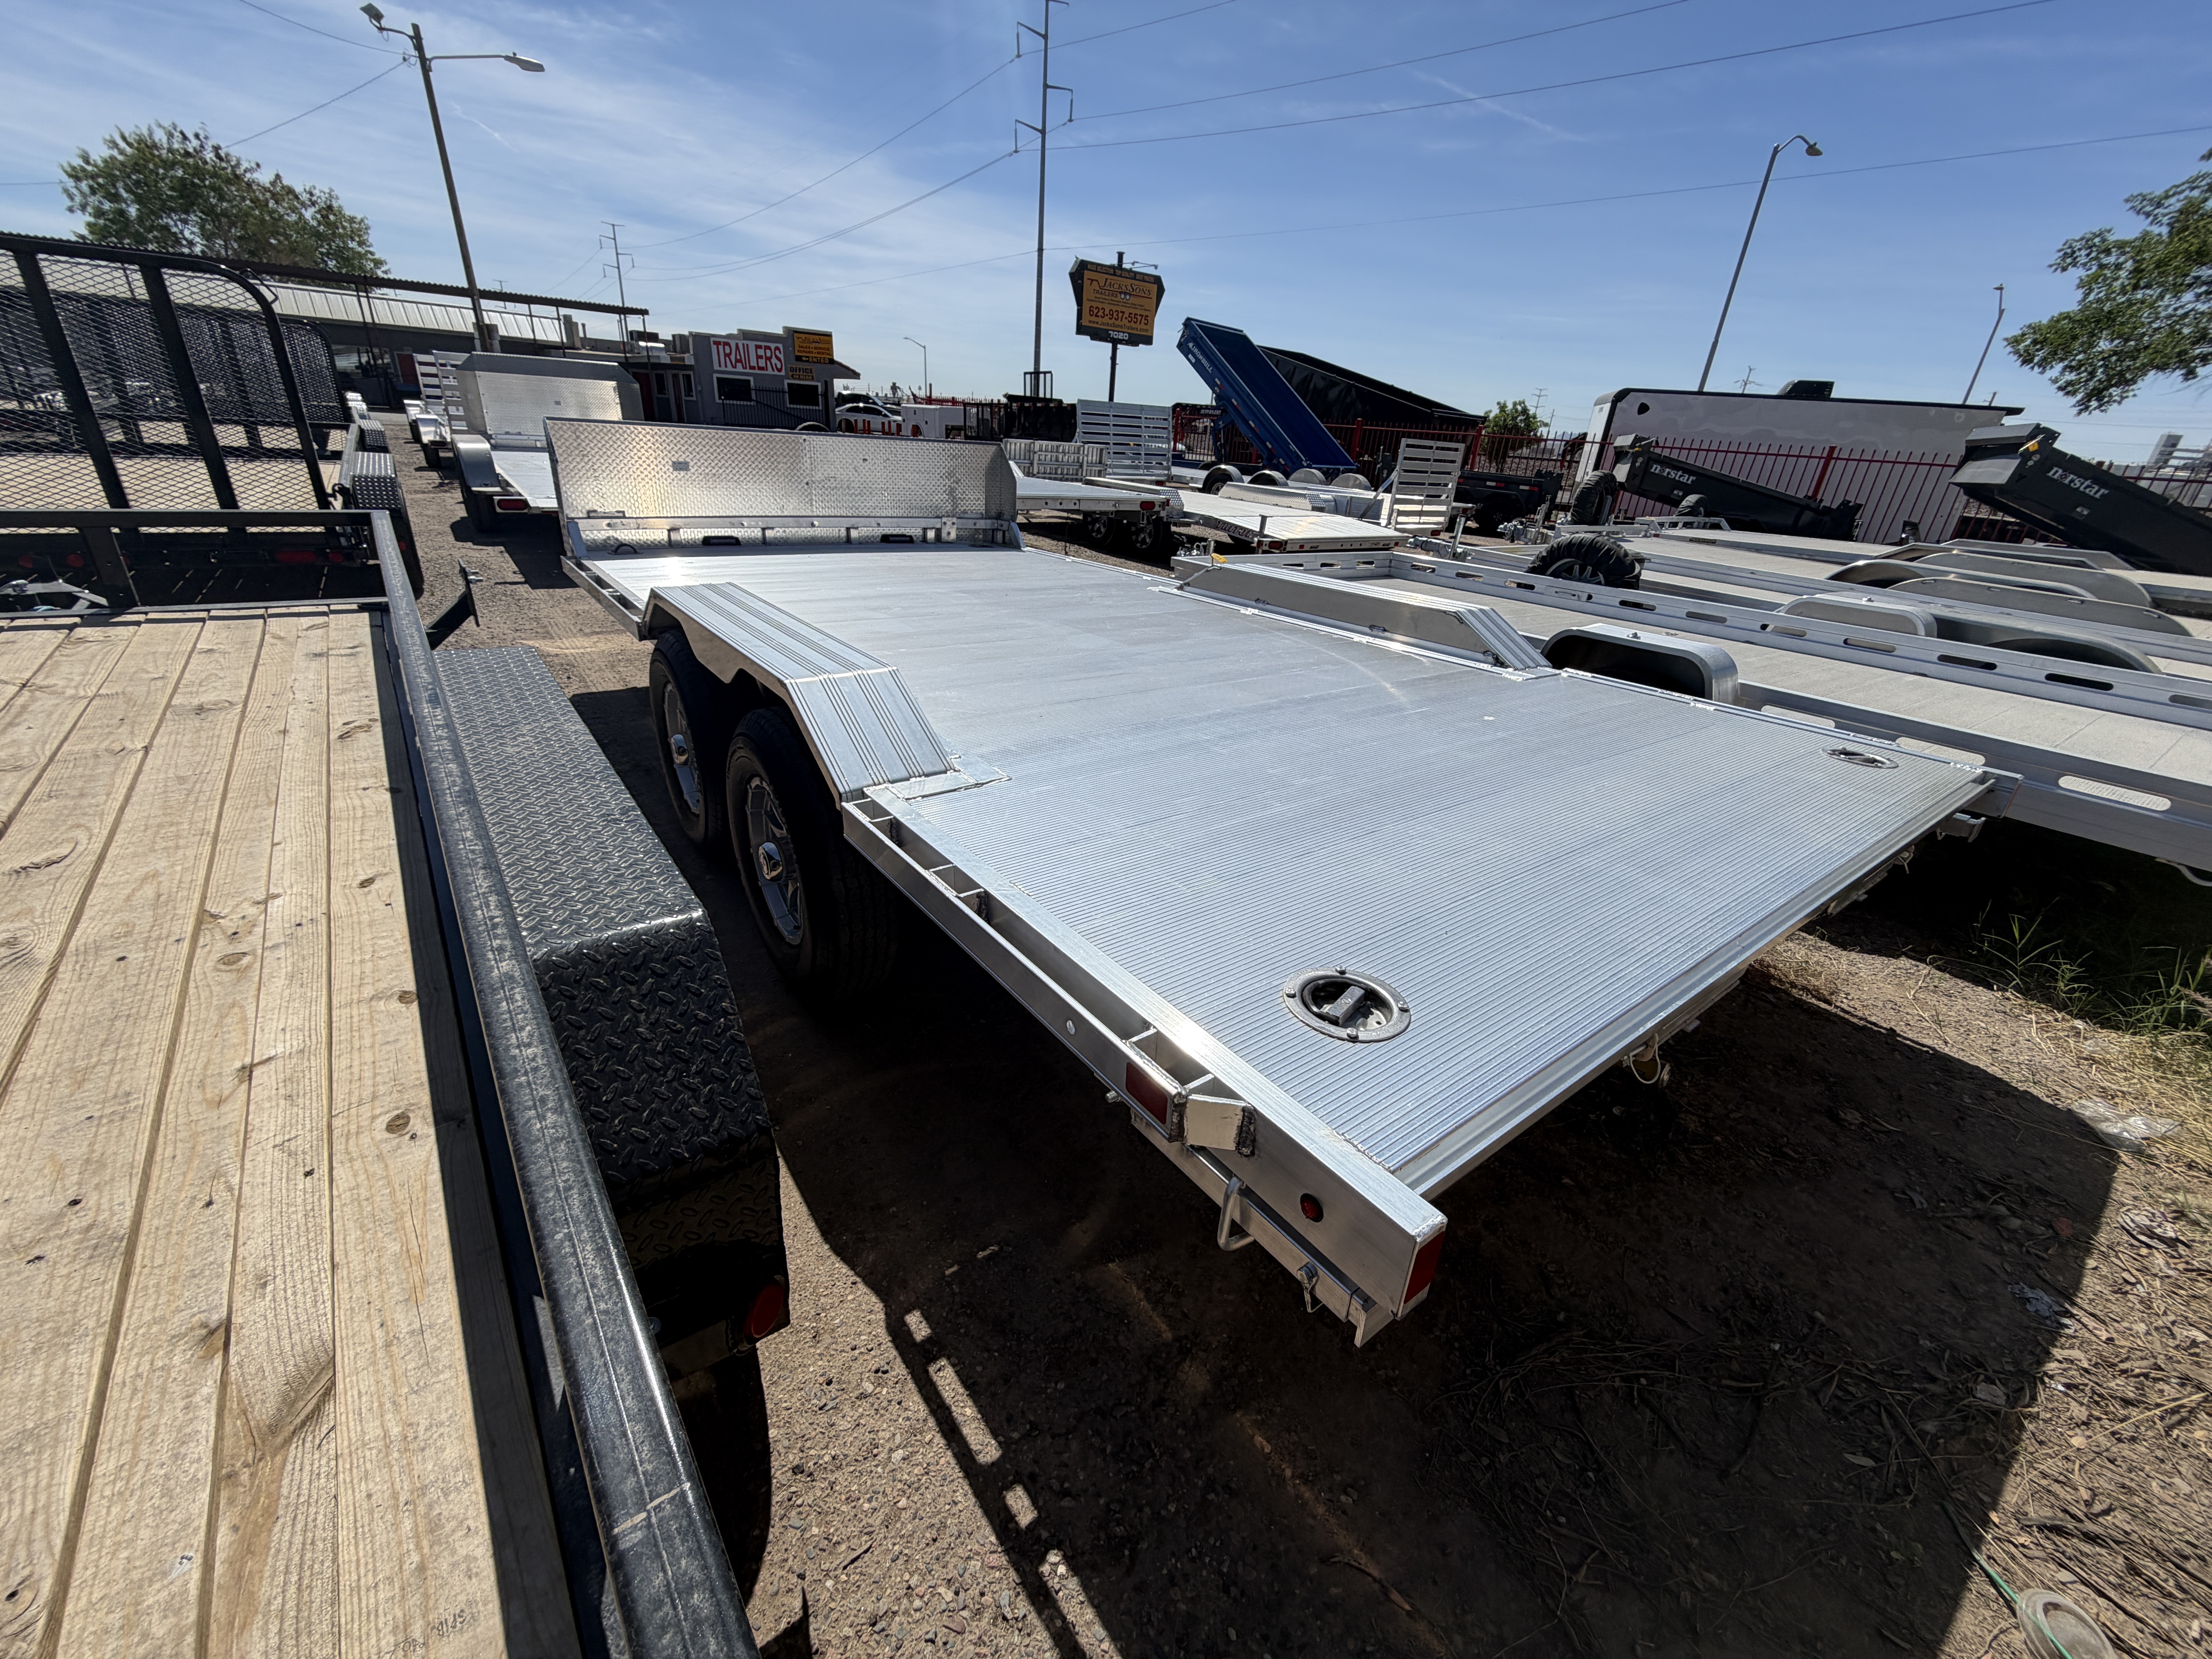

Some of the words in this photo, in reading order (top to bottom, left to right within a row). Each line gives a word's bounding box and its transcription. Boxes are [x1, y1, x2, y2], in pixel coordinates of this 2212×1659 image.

[1093, 289, 1118, 298] TRAILERS
[1089, 305, 1149, 326] 623-937-5575
[1108, 330, 1129, 340] 7020
[713, 340, 783, 373] TRAILERS
[1650, 464, 1697, 485] norstar
[2046, 466, 2109, 499] norstar
